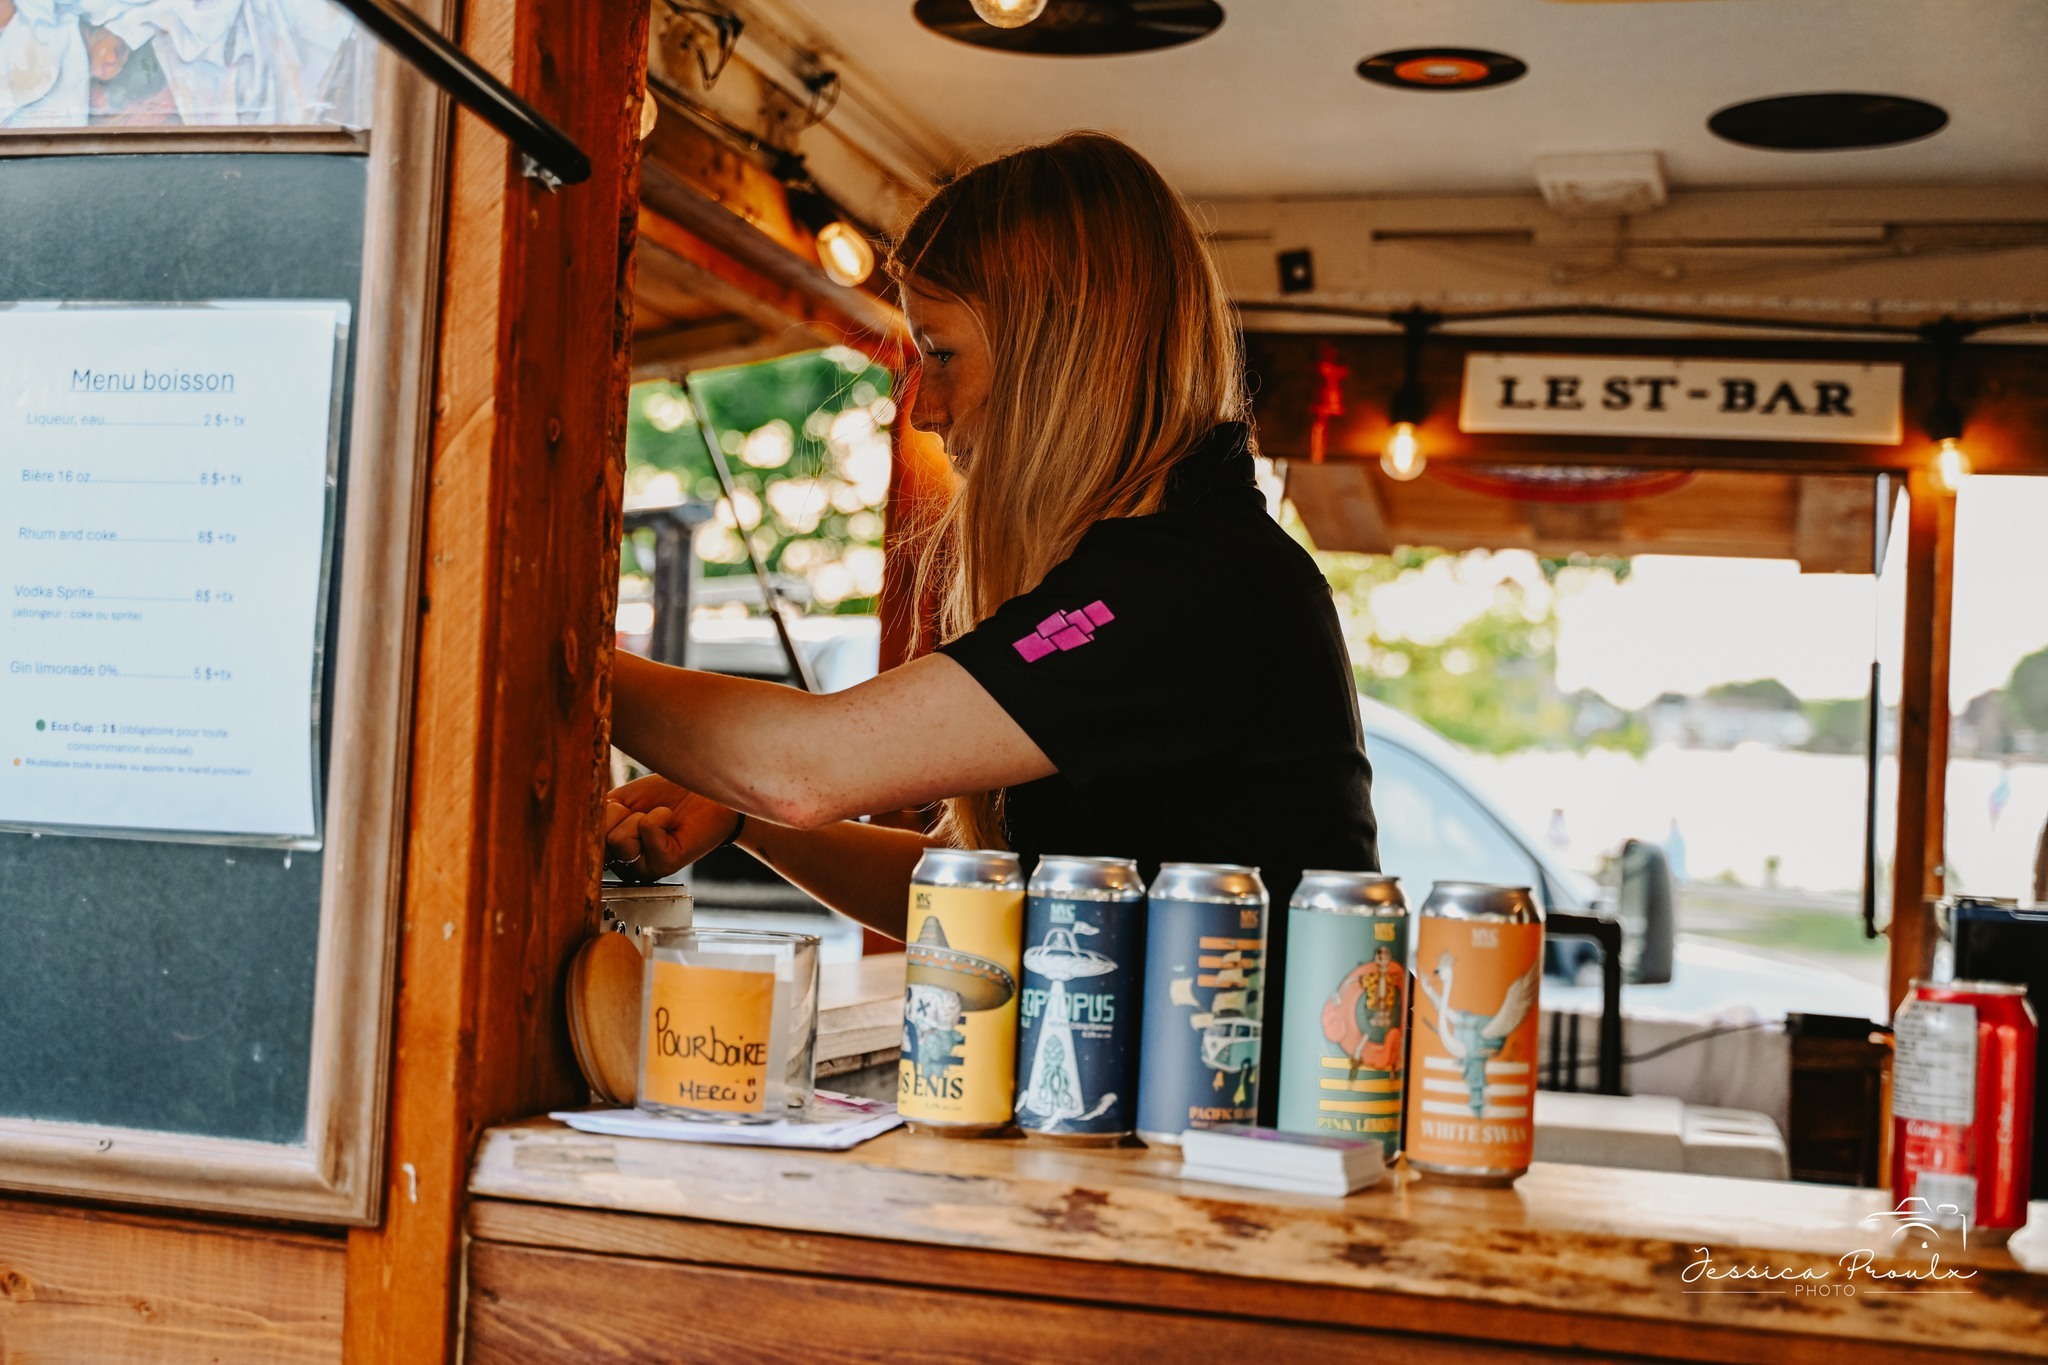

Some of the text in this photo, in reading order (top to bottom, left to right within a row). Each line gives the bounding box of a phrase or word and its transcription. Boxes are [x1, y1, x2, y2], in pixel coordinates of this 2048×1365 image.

[71, 368, 235, 391] Menu boisson
[1498, 375, 1584, 411] LE
[26, 412, 78, 427] Liqueur,
[203, 413, 212, 427] 2
[233, 414, 246, 427] tx
[21, 470, 54, 483] Bière
[58, 470, 73, 483] 16
[199, 471, 209, 485] 8
[230, 473, 243, 486] tx
[18, 527, 56, 542] Rhum
[59, 528, 83, 542] and
[14, 584, 54, 598] Vodka
[70, 609, 93, 619] coke
[95, 611, 109, 620] ou
[10, 660, 32, 674] Gin
[35, 662, 95, 677] limonade
[194, 667, 202, 681] 5
[51, 721, 70, 731] Eco
[73, 722, 94, 734] Cup
[102, 724, 108, 733] 2
[110, 724, 116, 734] $
[176, 728, 200, 739] pour
[202, 729, 228, 738] toute
[66, 741, 142, 752] consommation
[1421, 1119, 1479, 1143] WHITE
